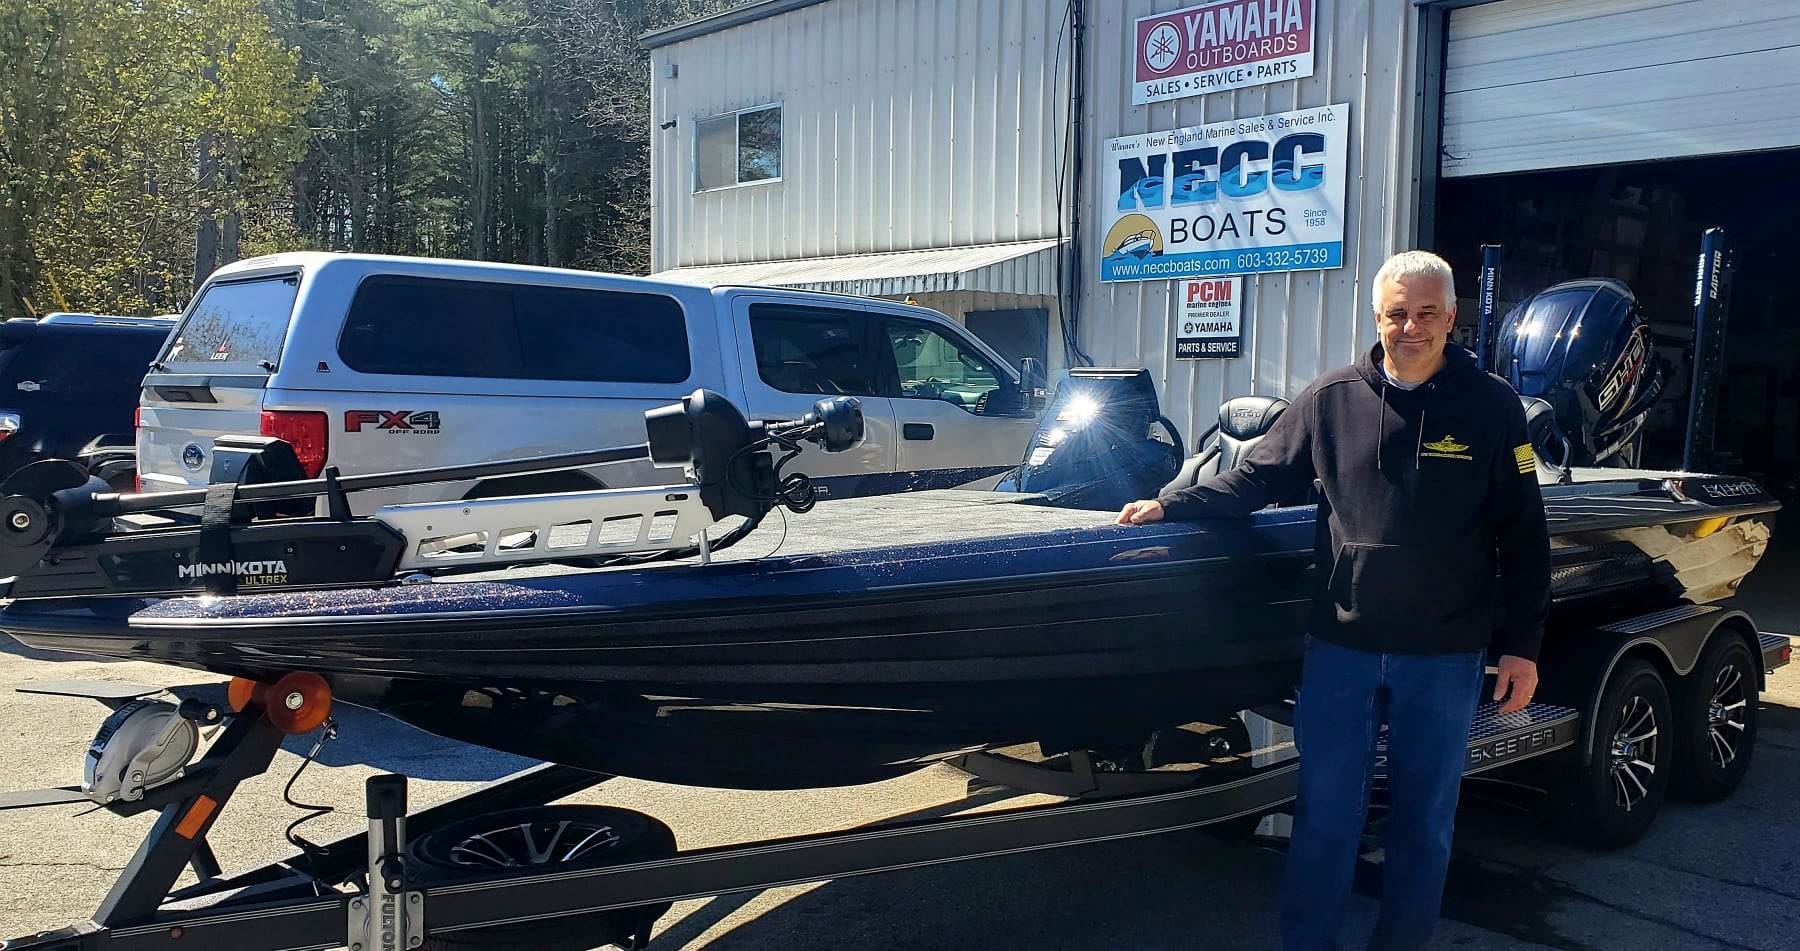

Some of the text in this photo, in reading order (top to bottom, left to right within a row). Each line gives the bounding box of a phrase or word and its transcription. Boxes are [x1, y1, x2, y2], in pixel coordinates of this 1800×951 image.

[1184, 0, 1303, 51] YAMAHA
[1187, 34, 1298, 69] OUTBOARDS
[1146, 60, 1297, 97] SALES SERVICE PARTS
[1146, 137, 1165, 147] New
[1168, 131, 1203, 146] England
[1205, 126, 1236, 140] Marine
[1238, 121, 1265, 134] Sales
[1267, 120, 1275, 130] &
[1278, 115, 1314, 129] Service
[1318, 111, 1336, 123] Inc.
[1118, 132, 1325, 210] NECC
[1169, 207, 1287, 243] BOATS
[1303, 208, 1328, 218] Since
[1304, 217, 1326, 228] 1958
[1112, 248, 1328, 276] www.neccboats.com 603-332-5739
[1710, 250, 1722, 299] RAPTOR
[1187, 280, 1232, 302] PCM
[1484, 267, 1495, 315] MINN KOTA
[1194, 321, 1233, 332] YAMAHA
[1178, 341, 1237, 352] PARTS & SERVICE
[344, 410, 440, 432] FX4
[236, 560, 287, 575] KOTA
[245, 575, 288, 585] ULTREX
[1471, 729, 1556, 764] SKEETER
